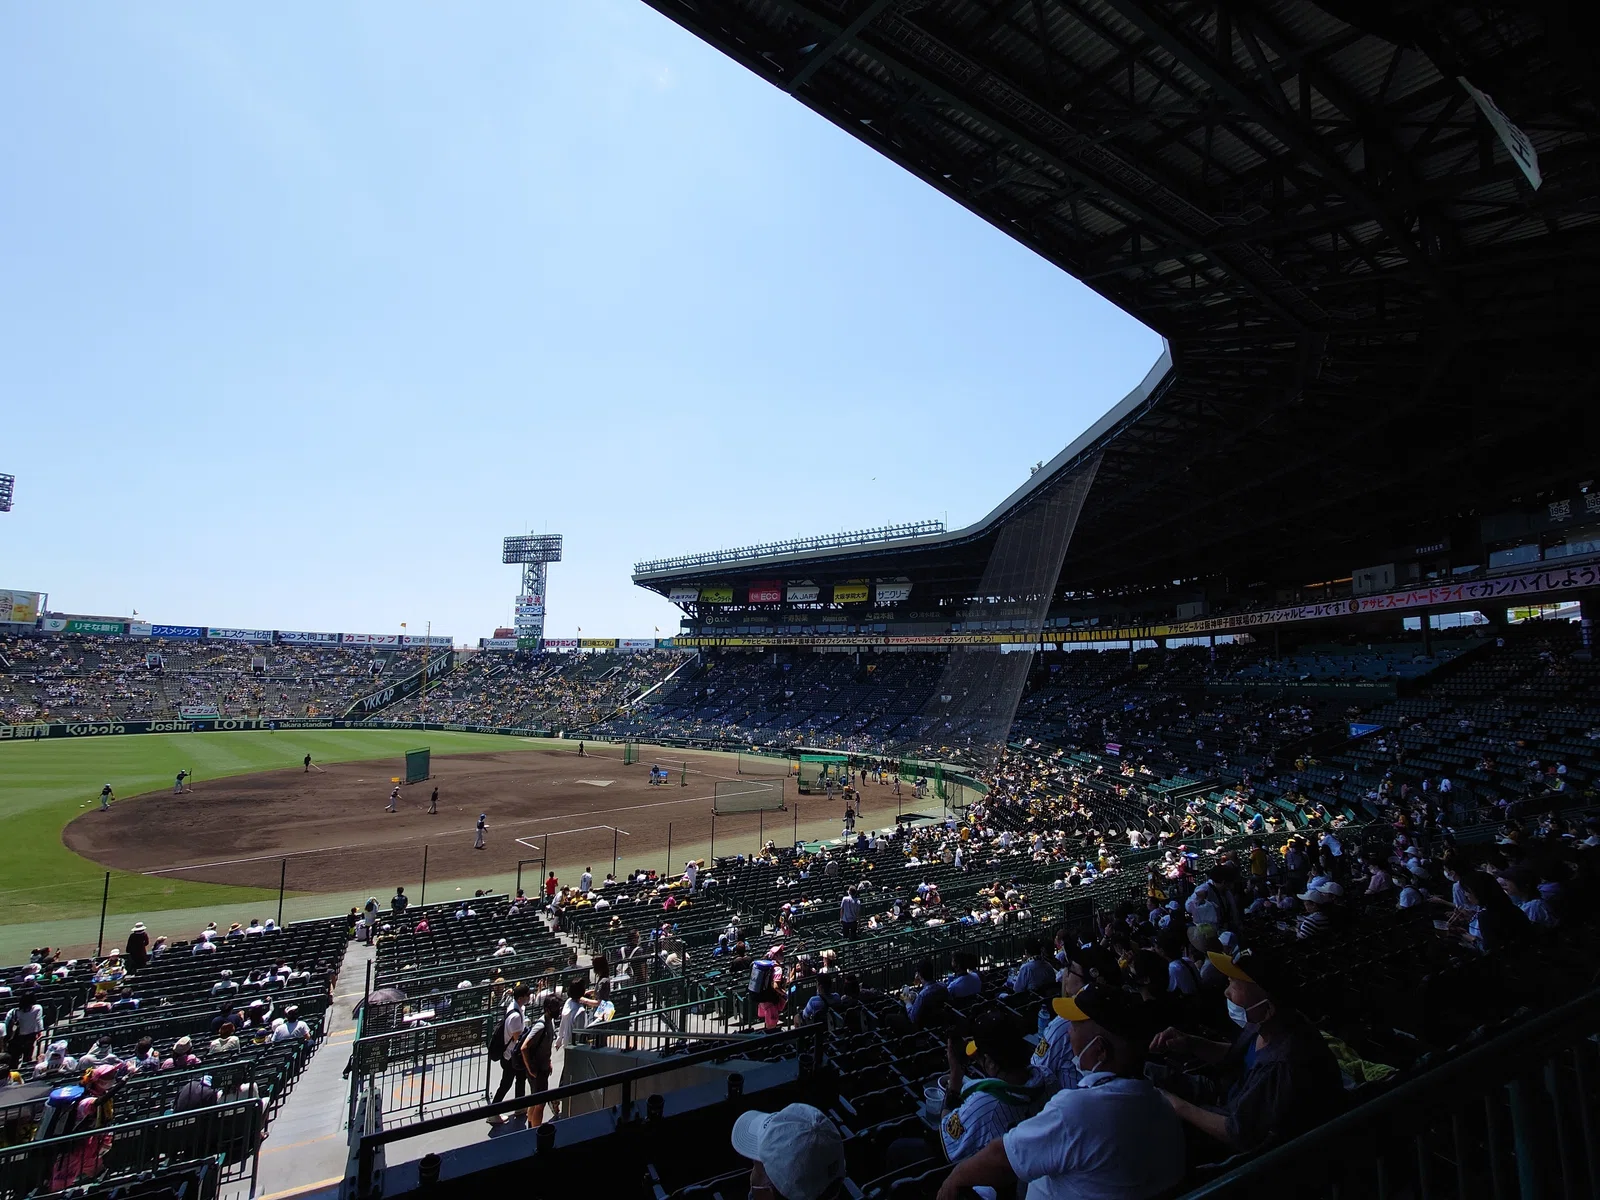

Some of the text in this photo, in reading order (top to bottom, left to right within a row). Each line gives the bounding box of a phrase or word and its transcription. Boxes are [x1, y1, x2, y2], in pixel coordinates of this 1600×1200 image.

[1551, 504, 1569, 515] 1962
[760, 593, 778, 601] ECC
[75, 622, 119, 632] りそな銀行
[152, 626, 199, 636] シスメックス
[221, 629, 272, 640] エスケー化研
[297, 633, 337, 642] 大同工業
[345, 635, 396, 643] カニトップ
[427, 656, 448, 678] YKK
[363, 694, 382, 711] YKK
[66, 722, 125, 735] Kubota
[214, 719, 270, 730] LOTTE
